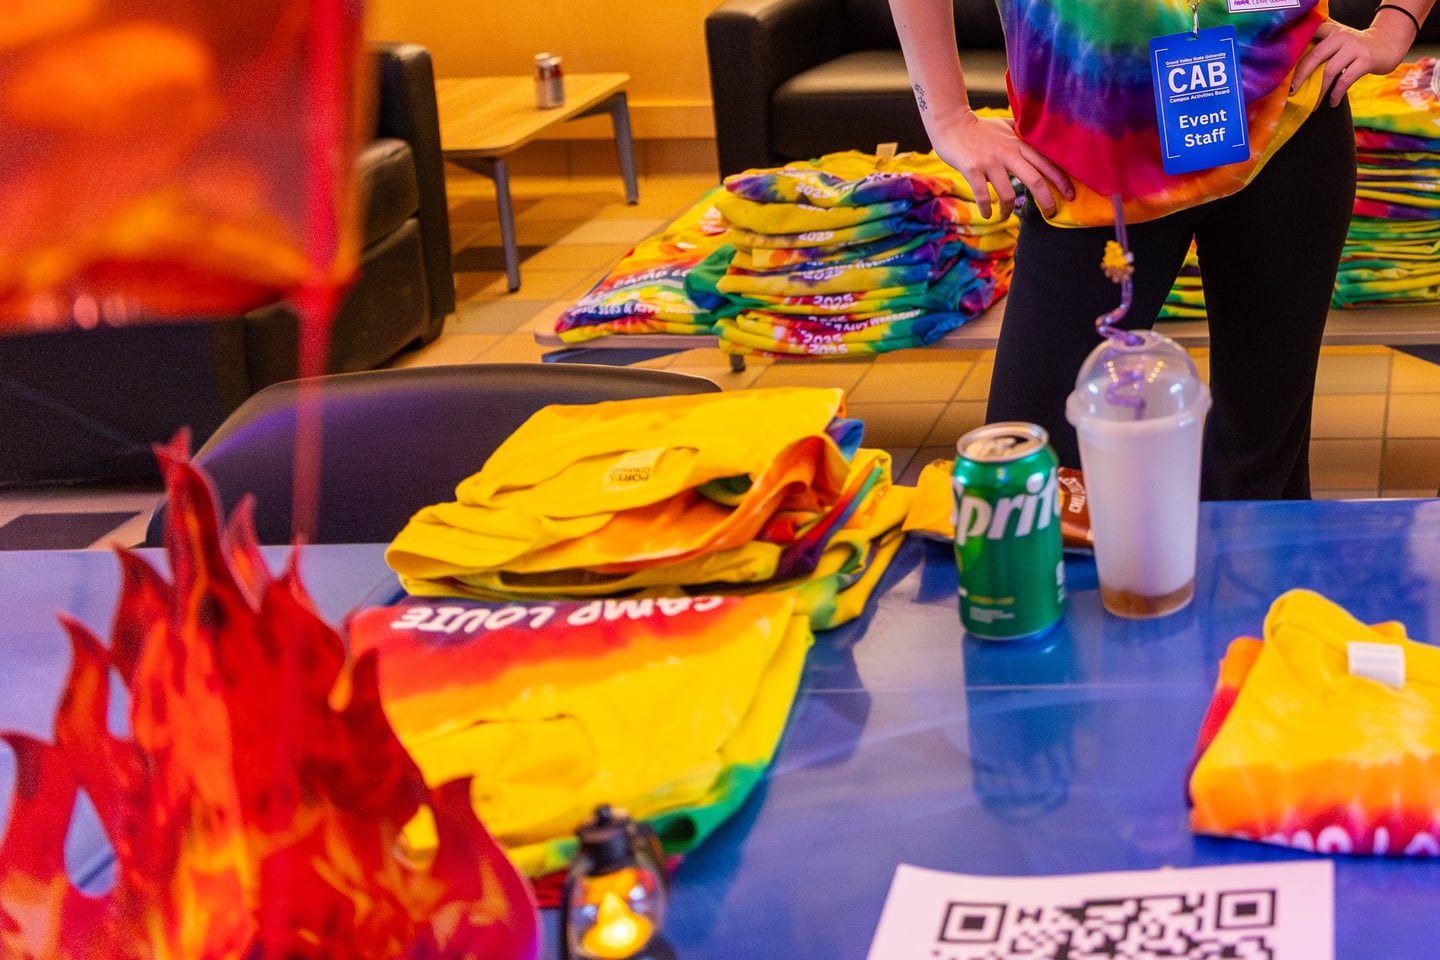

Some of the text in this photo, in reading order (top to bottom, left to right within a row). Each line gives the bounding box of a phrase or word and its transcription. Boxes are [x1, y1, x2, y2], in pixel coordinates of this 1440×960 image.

[1168, 61, 1228, 94] CAB
[1178, 109, 1227, 129] Event
[1184, 127, 1226, 148] Staff
[951, 467, 1062, 546] prit
[390, 596, 724, 634] CAMP LOUIE
